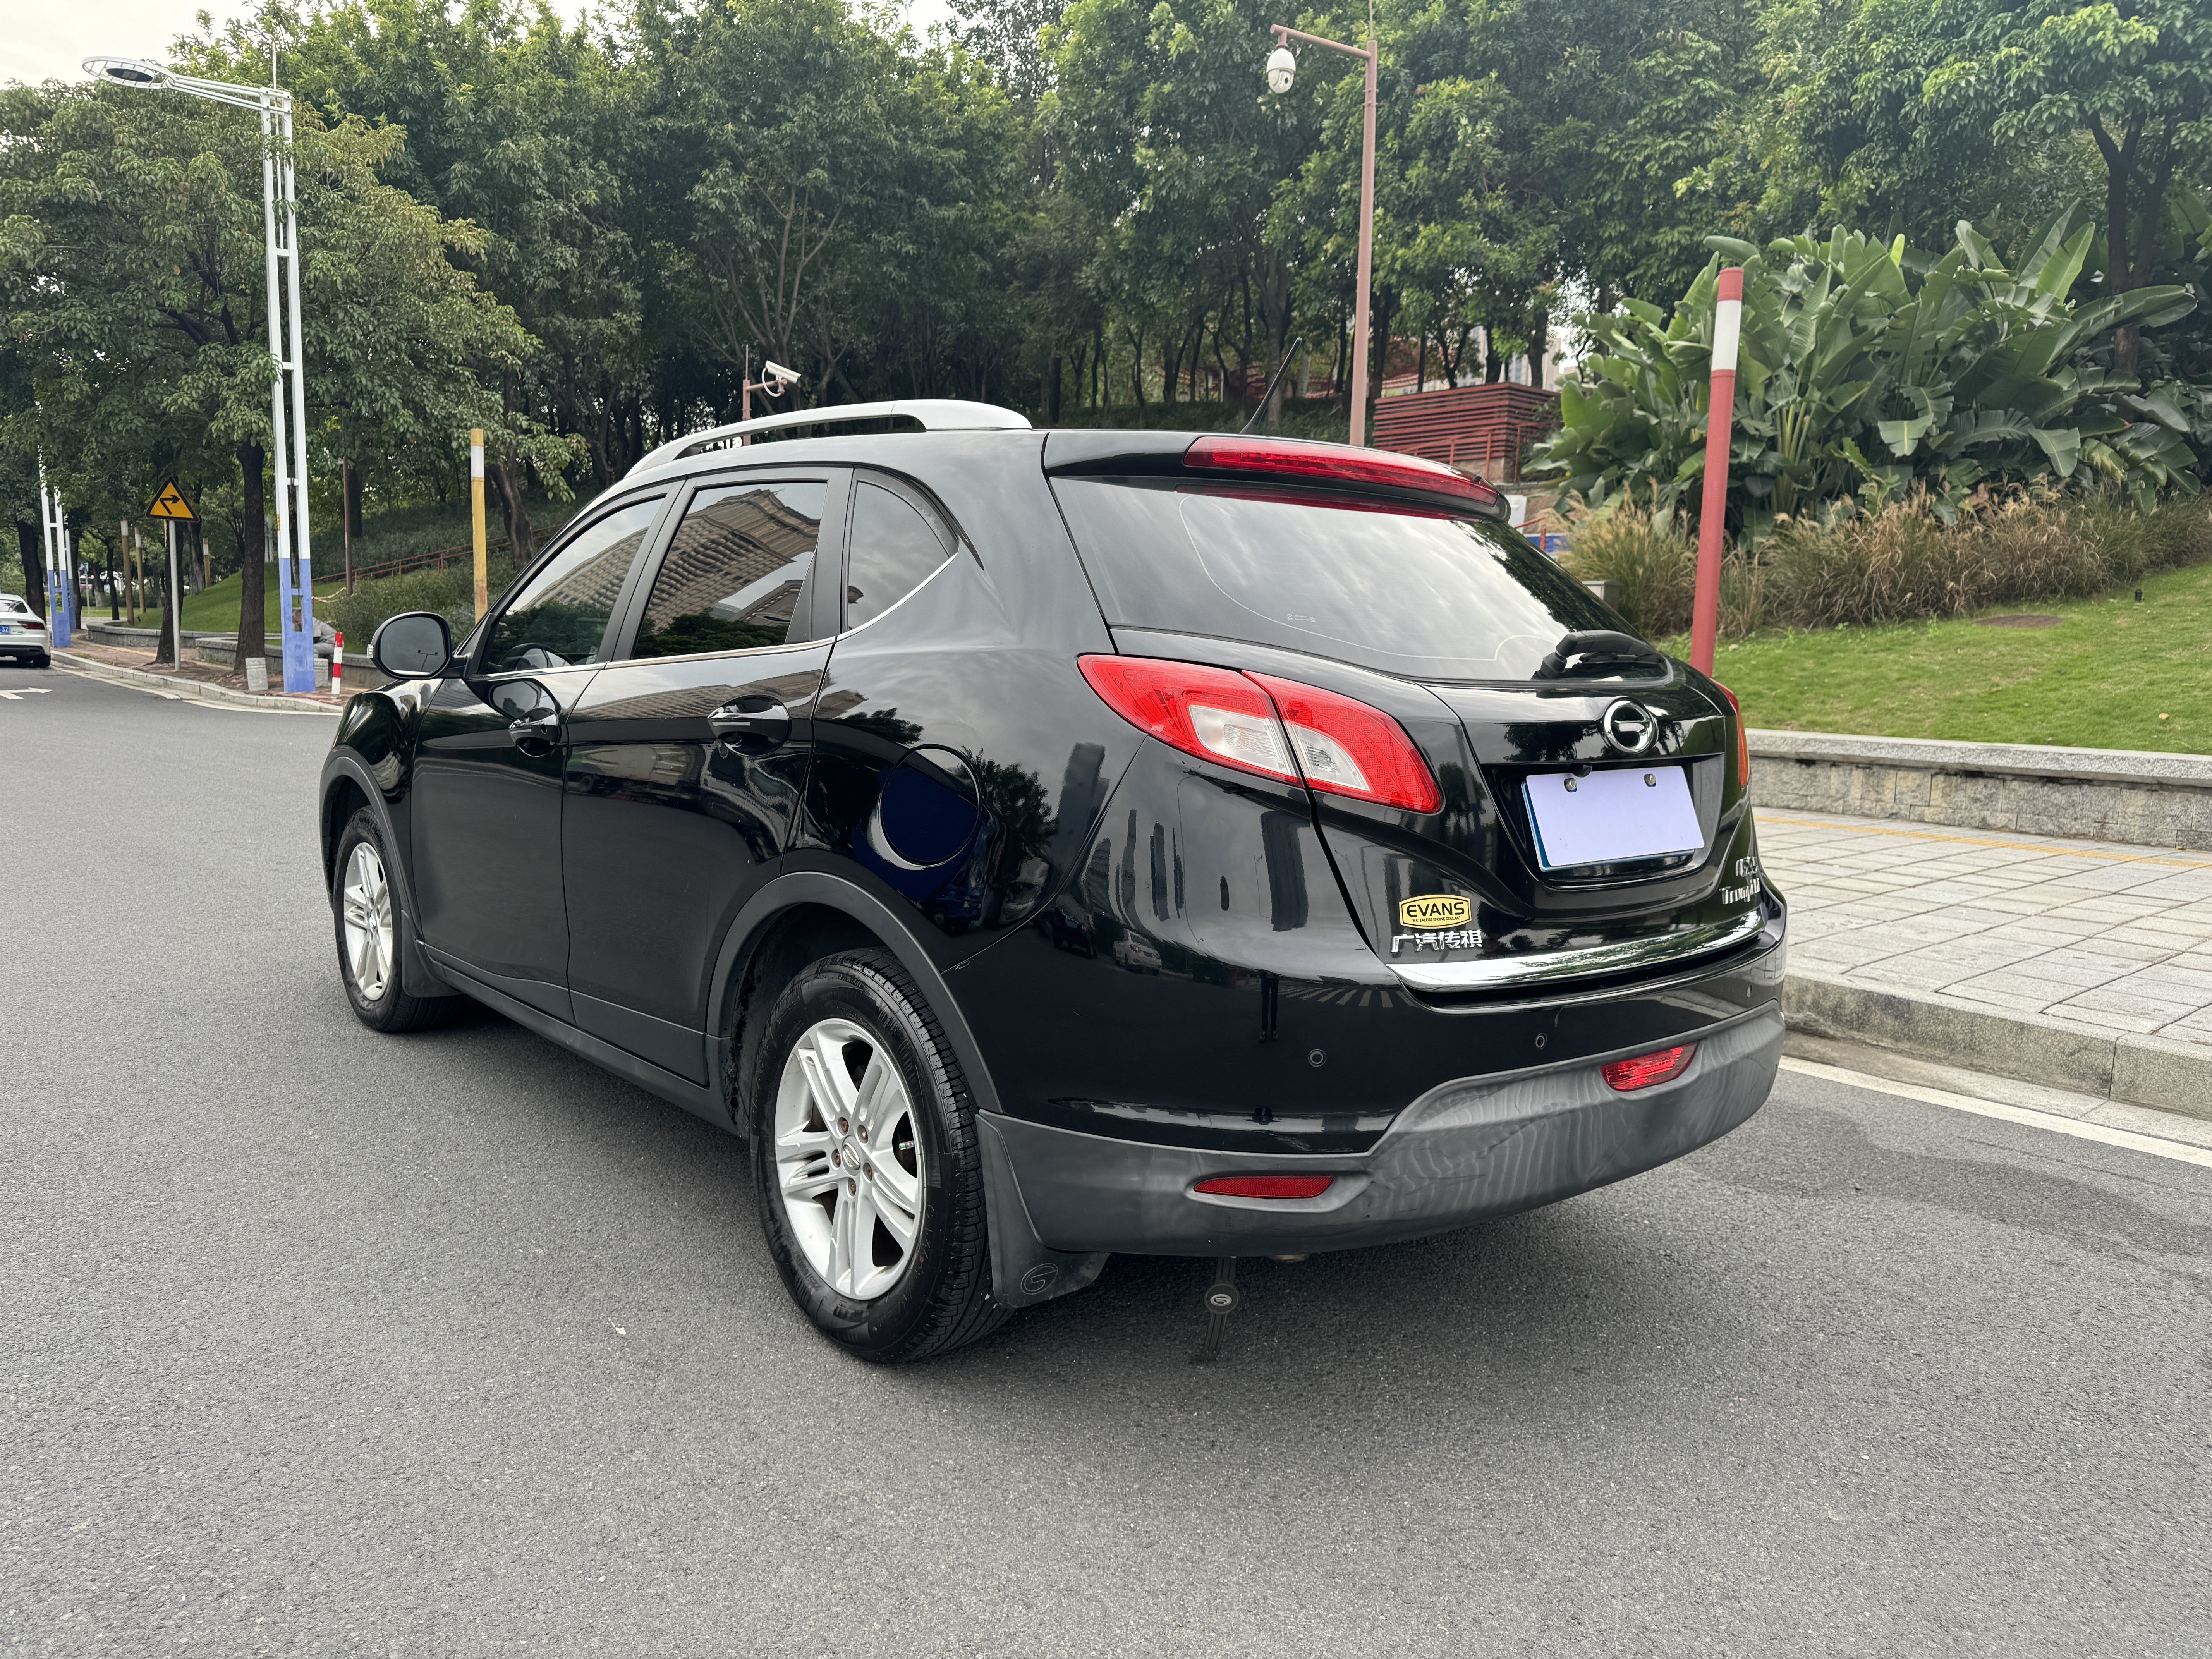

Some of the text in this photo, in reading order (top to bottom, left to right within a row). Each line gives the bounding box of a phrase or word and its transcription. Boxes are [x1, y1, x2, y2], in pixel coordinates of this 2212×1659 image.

[1407, 902, 1465, 917] EVANS
[1391, 930, 1482, 953] 广汽传祺
